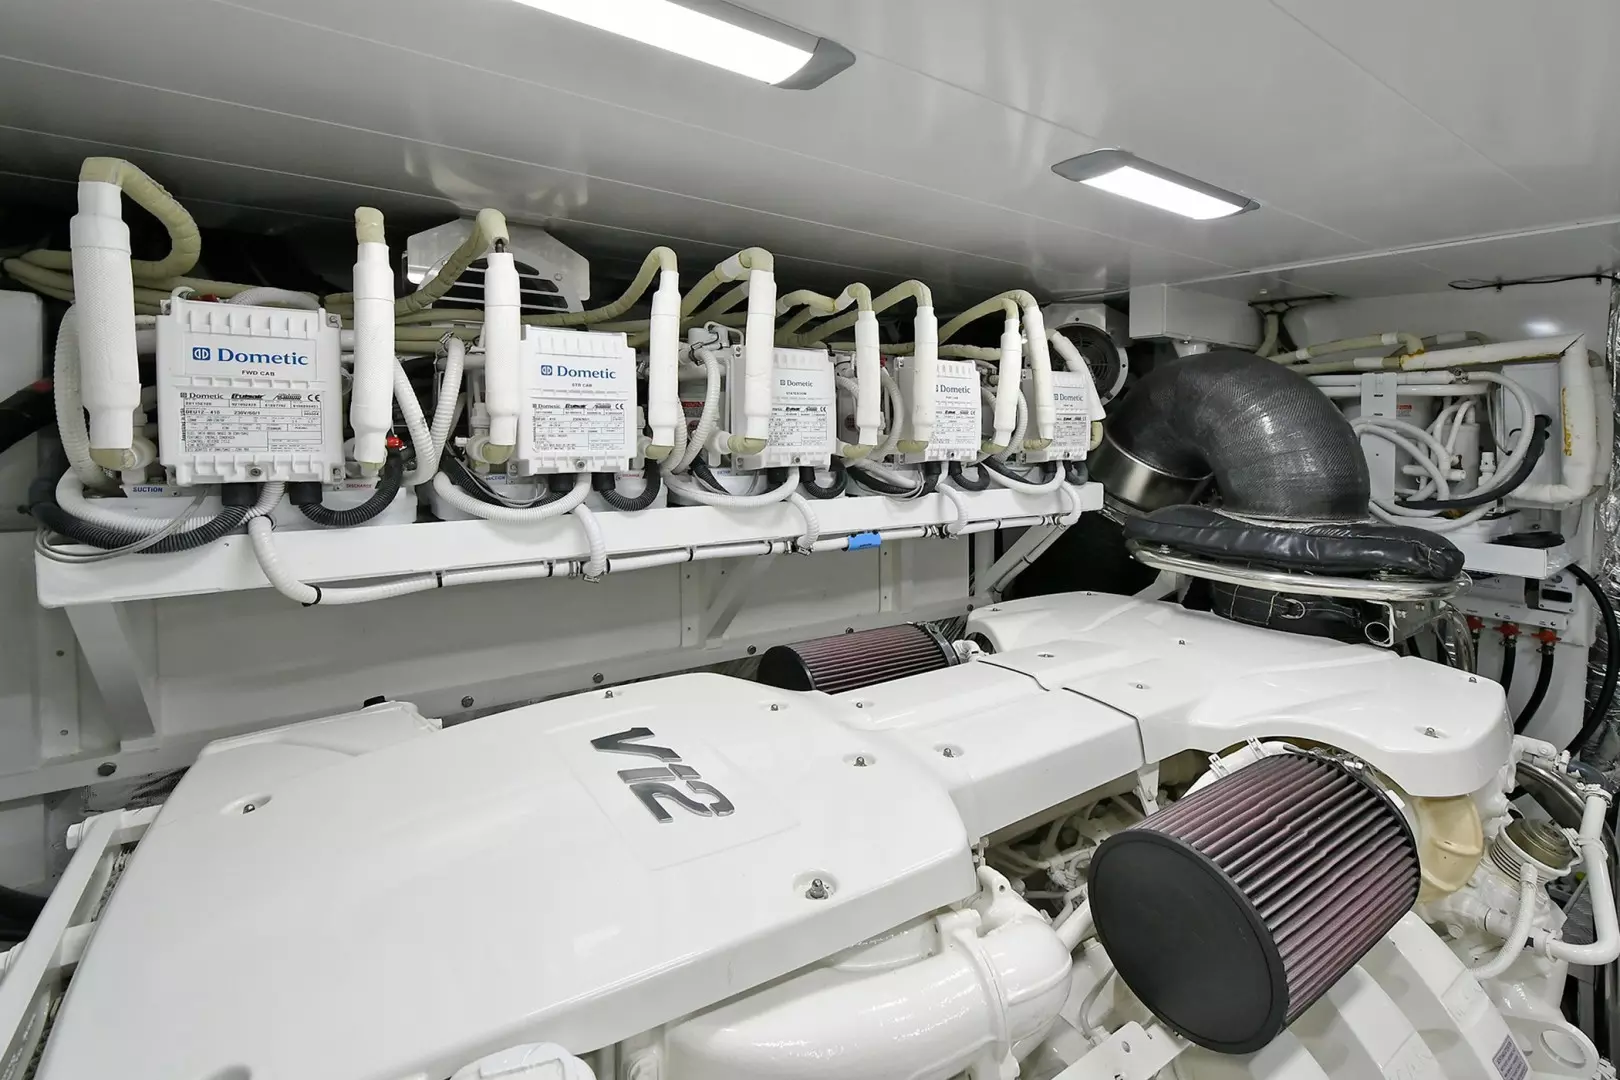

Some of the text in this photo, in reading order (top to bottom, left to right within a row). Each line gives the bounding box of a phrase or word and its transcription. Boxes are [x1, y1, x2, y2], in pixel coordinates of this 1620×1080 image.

[217, 348, 309, 366] Dometic
[557, 365, 617, 379] Dometic
[940, 384, 971, 394] Dometic
[189, 392, 224, 400] Dometic
[1059, 393, 1084, 402] Dometic
